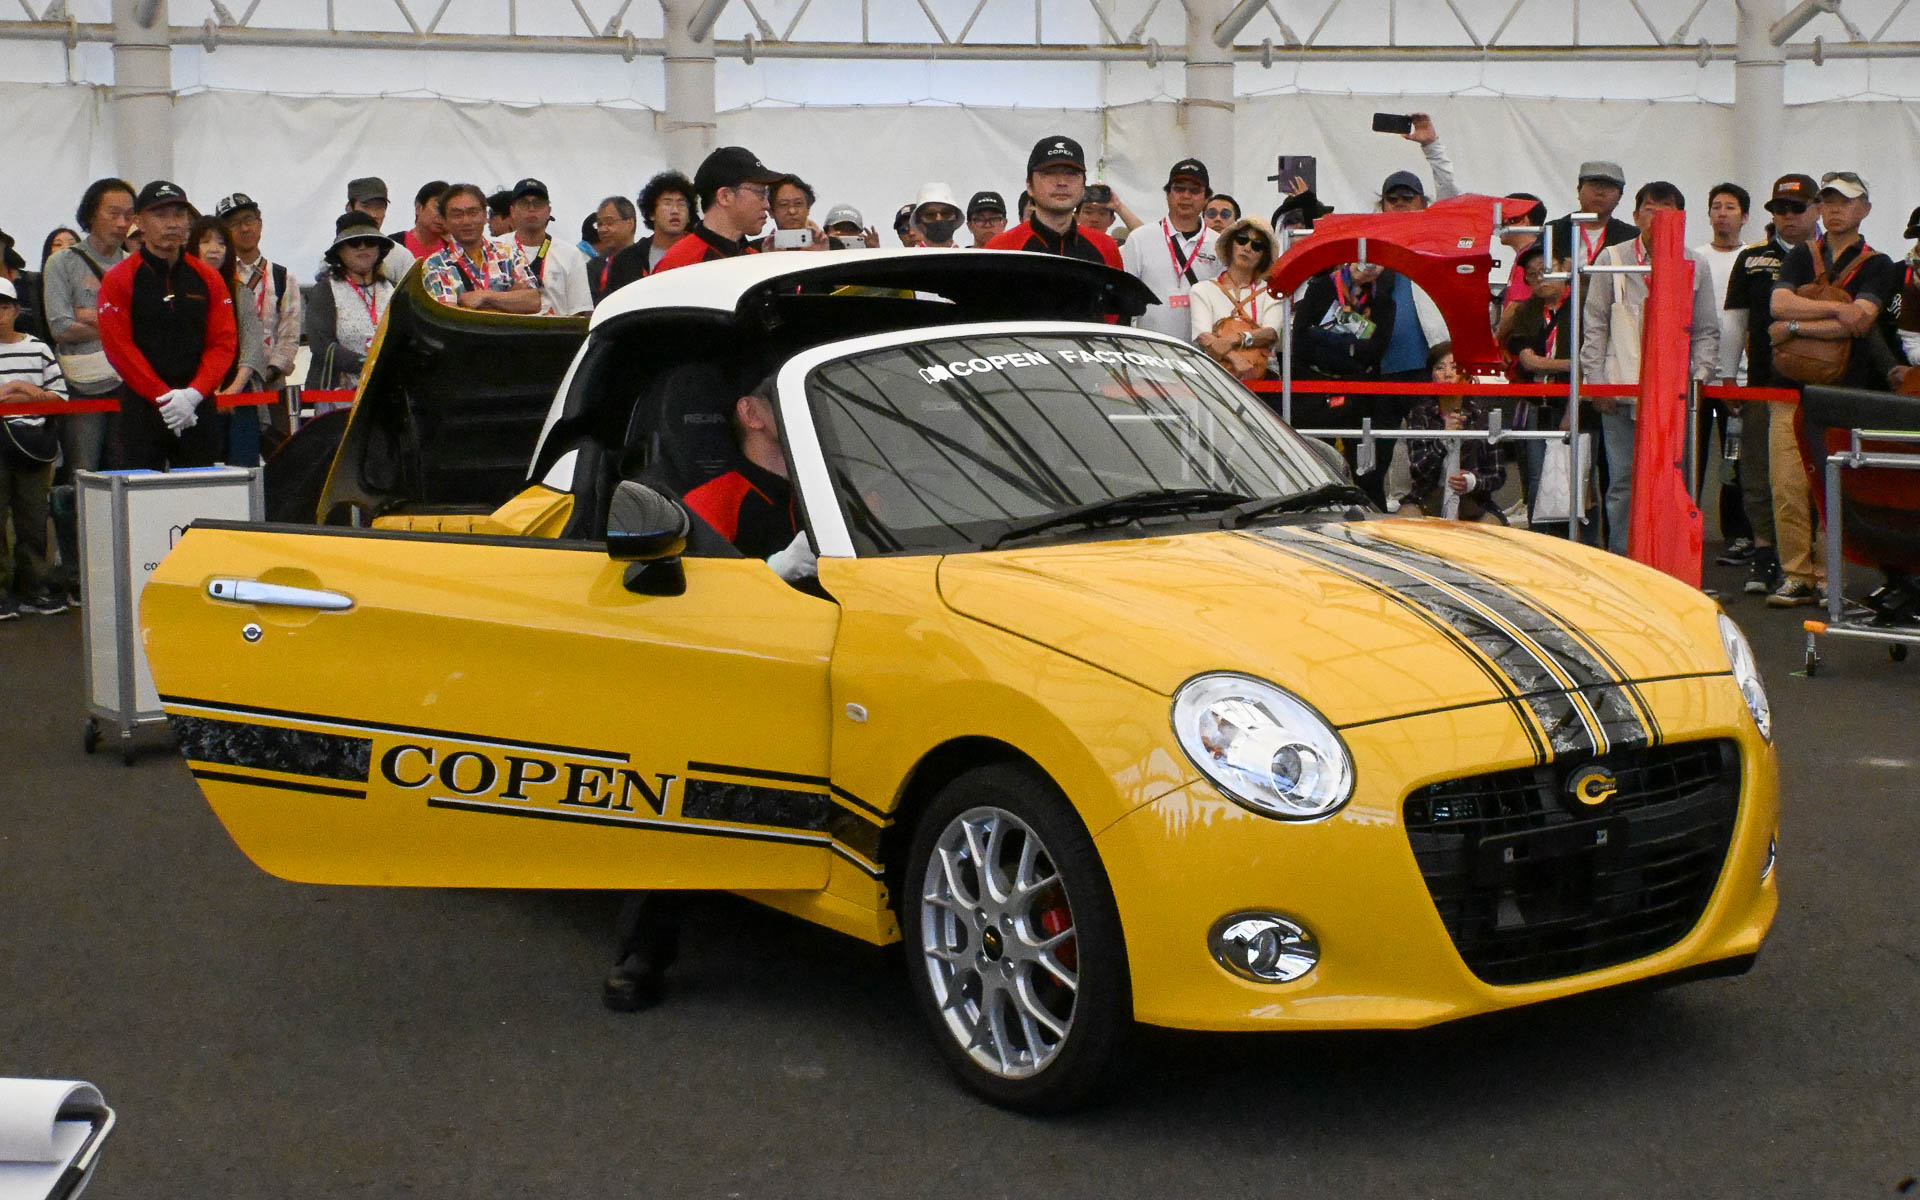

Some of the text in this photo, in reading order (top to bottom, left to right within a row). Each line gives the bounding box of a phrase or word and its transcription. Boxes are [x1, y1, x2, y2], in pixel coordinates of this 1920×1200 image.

[1047, 149, 1073, 157] COPEN
[949, 350, 1174, 377] COPEN FACTORY
[380, 743, 677, 817] COPEN
